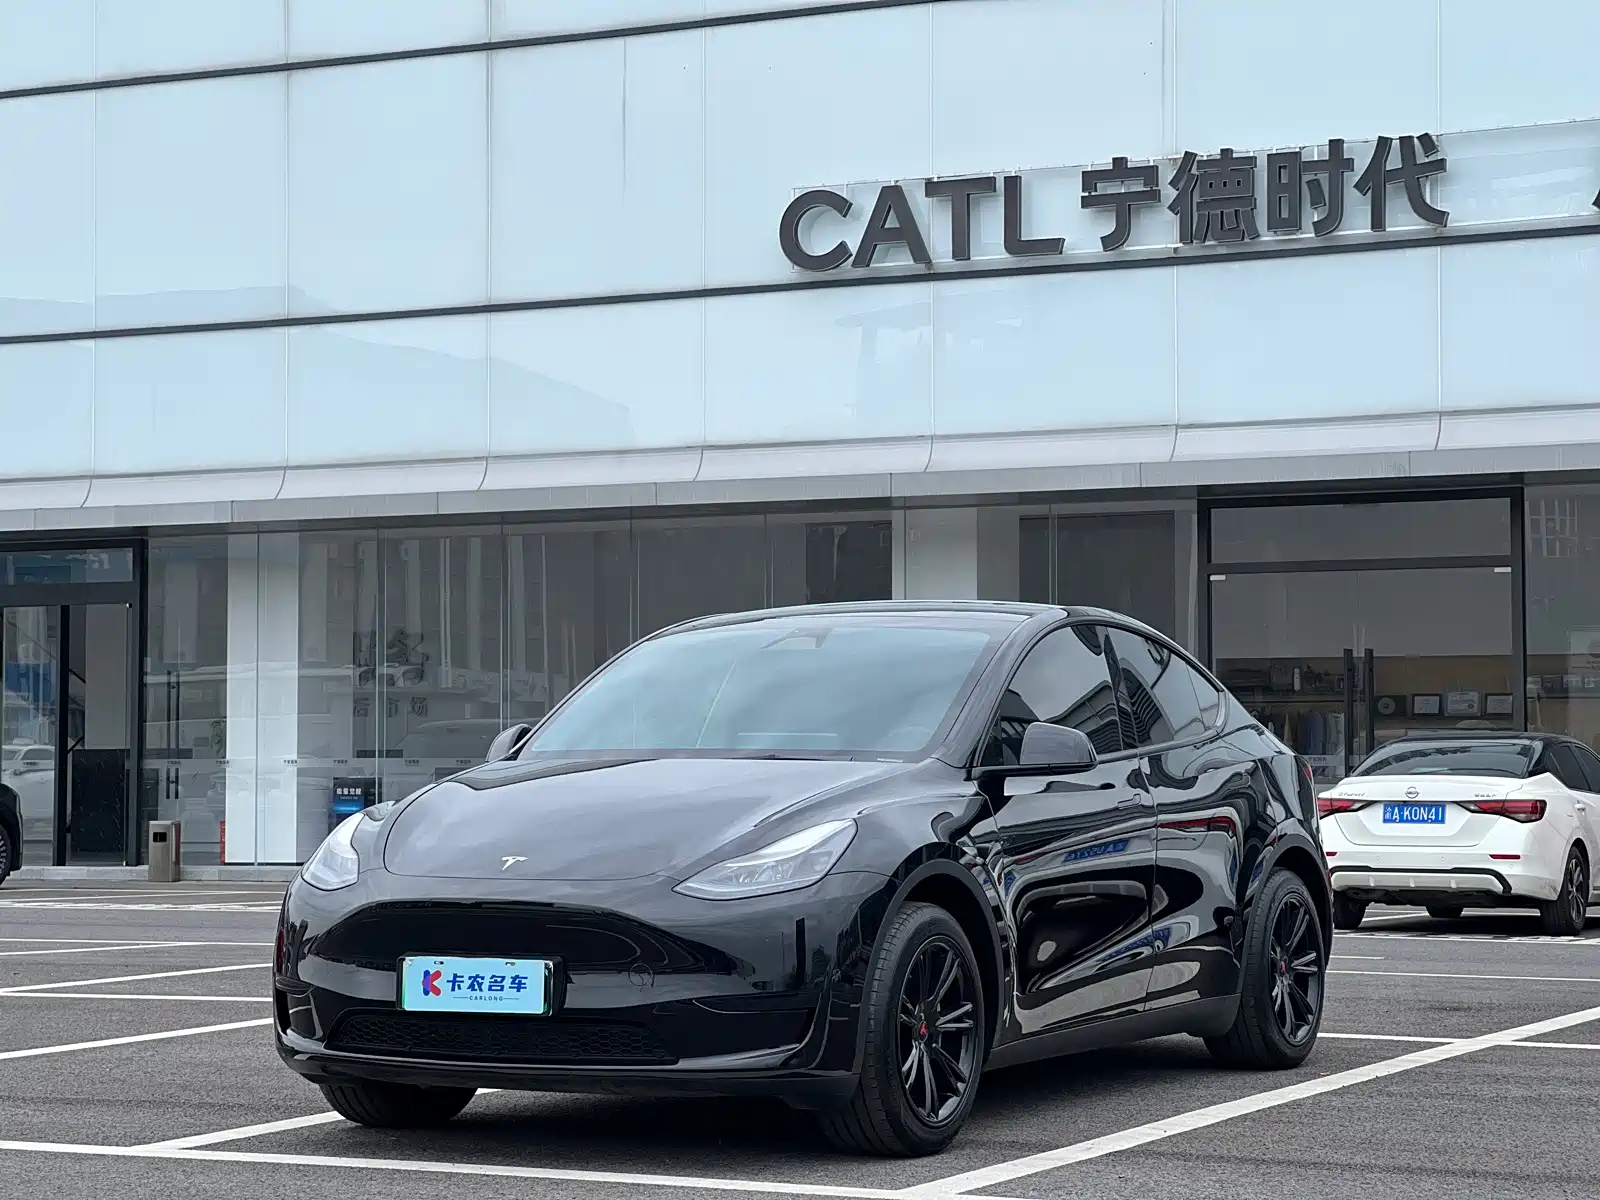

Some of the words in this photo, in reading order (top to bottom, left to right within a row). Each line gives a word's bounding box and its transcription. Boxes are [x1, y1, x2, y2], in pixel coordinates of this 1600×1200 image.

[779, 175, 1066, 273] CATL
[1080, 132, 1450, 252] 宁德时代
[446, 973, 528, 993] 卡农名车
